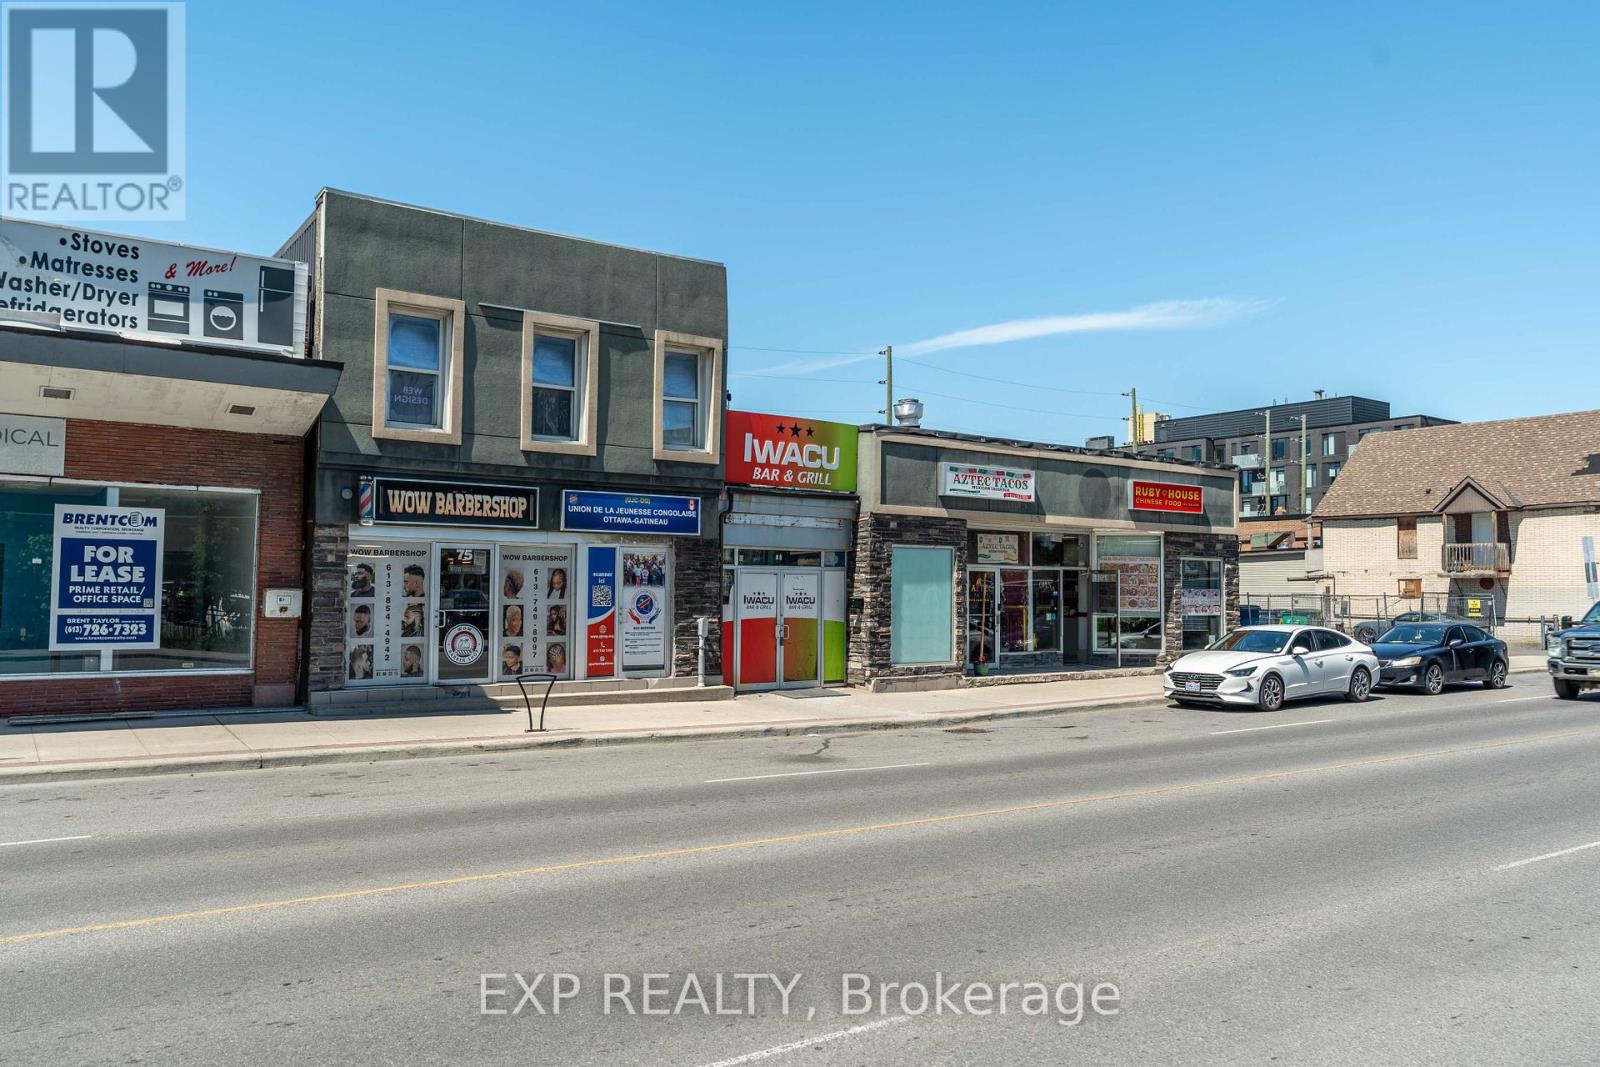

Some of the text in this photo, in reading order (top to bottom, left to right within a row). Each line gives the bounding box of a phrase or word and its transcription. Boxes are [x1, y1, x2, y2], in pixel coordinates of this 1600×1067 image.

[70, 232, 140, 260] Stoves
[30, 250, 138, 283] Matresses
[165, 256, 237, 279] & More!
[0, 428, 59, 447] ICAL
[744, 432, 840, 470] IWACU
[752, 467, 832, 485] BAR & GRILL
[953, 473, 1028, 490] AZTEC TACOS
[1135, 486, 1200, 501] RUBY HOUSE
[387, 489, 527, 519] WOW BARBERSHOP
[1135, 498, 1163, 506] CHINESE
[568, 505, 592, 513] UNION
[616, 507, 652, 516] JEUNESSE
[653, 509, 697, 518] CONGOLAISE
[603, 516, 669, 526] OTTAWA-GATINEAU
[83, 545, 134, 563] FOR
[456, 549, 473, 561] 75
[70, 564, 146, 583] LEASE
[69, 585, 146, 595] PRIME RETAIL/
[73, 595, 142, 603] OFFICE SPACE
[743, 595, 774, 605] IWACU
[786, 595, 816, 605] IWACU
[64, 625, 83, 634] (613)
